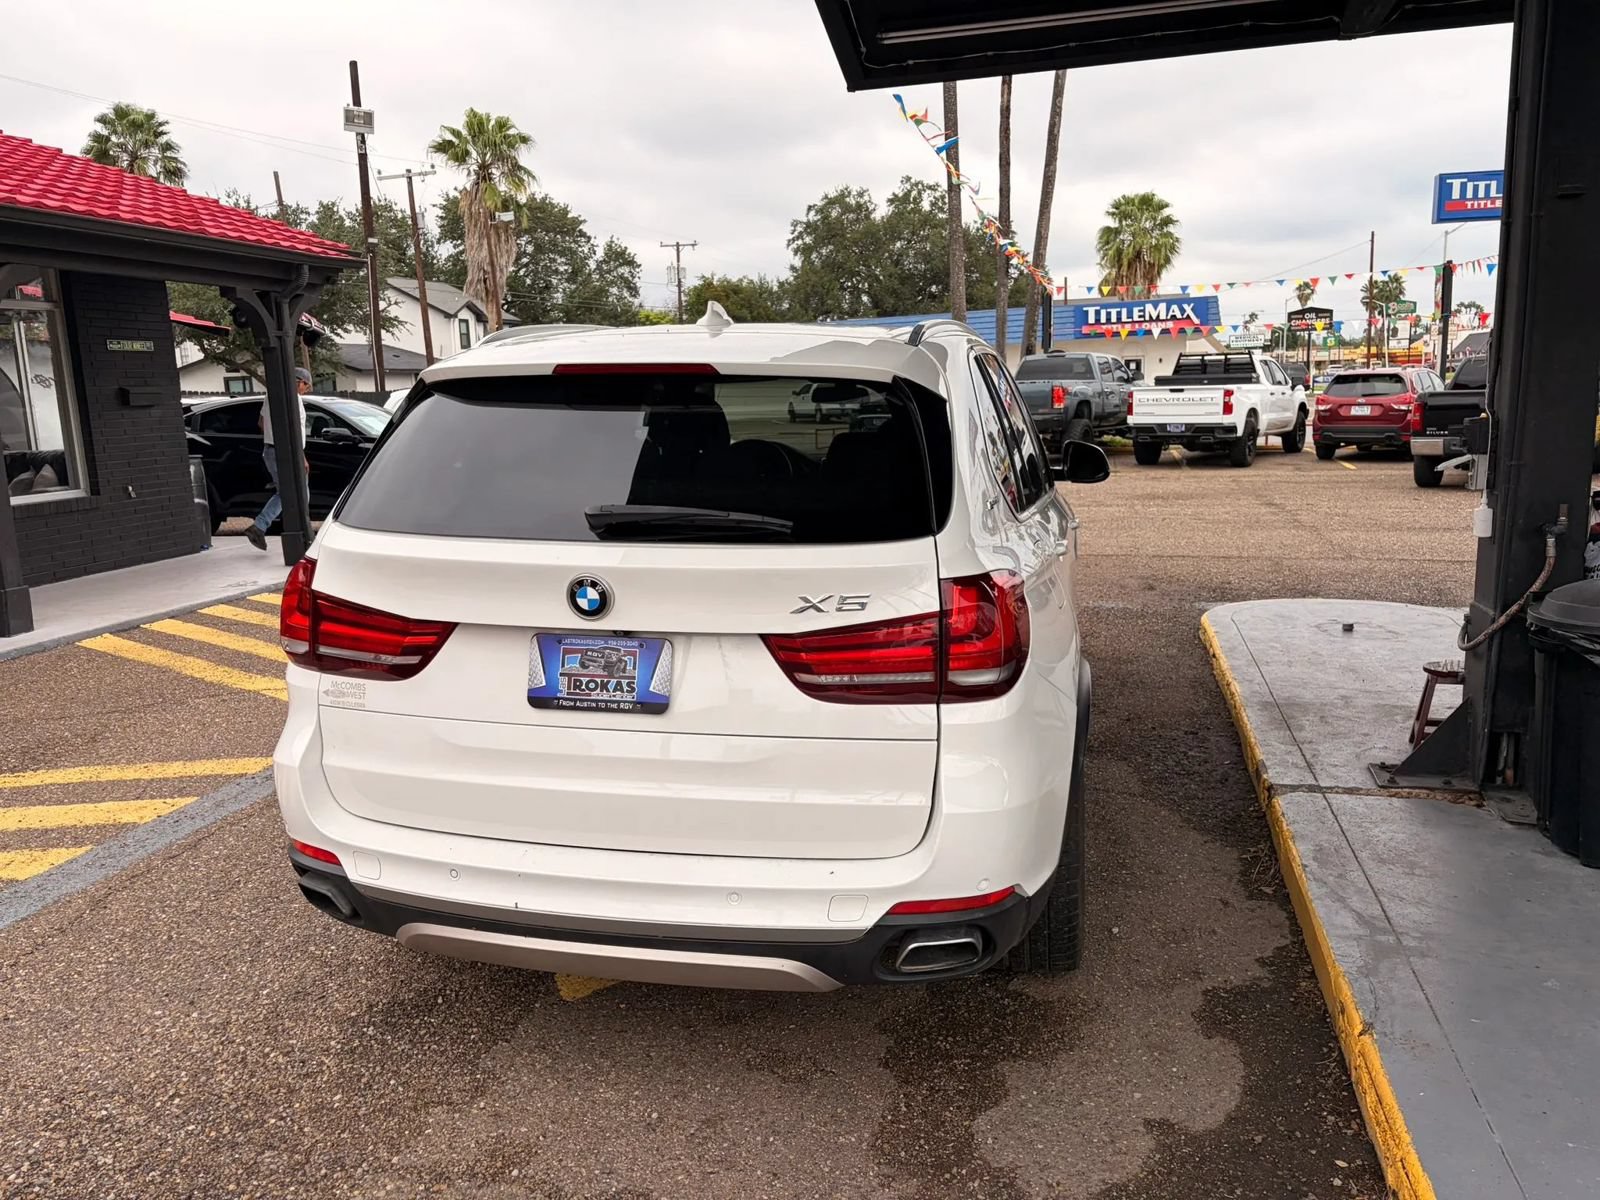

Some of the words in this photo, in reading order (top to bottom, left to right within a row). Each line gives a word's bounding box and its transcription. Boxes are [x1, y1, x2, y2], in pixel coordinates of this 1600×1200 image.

[1446, 178, 1503, 200] TITL
[1465, 199, 1503, 209] TITLE
[1135, 321, 1174, 330] LOANS
[572, 579, 604, 593] BMW
[789, 592, 872, 614] X5
[330, 680, 367, 691] McCOMBS
[565, 675, 637, 694] TROKAS
[347, 690, 367, 700] WEST
